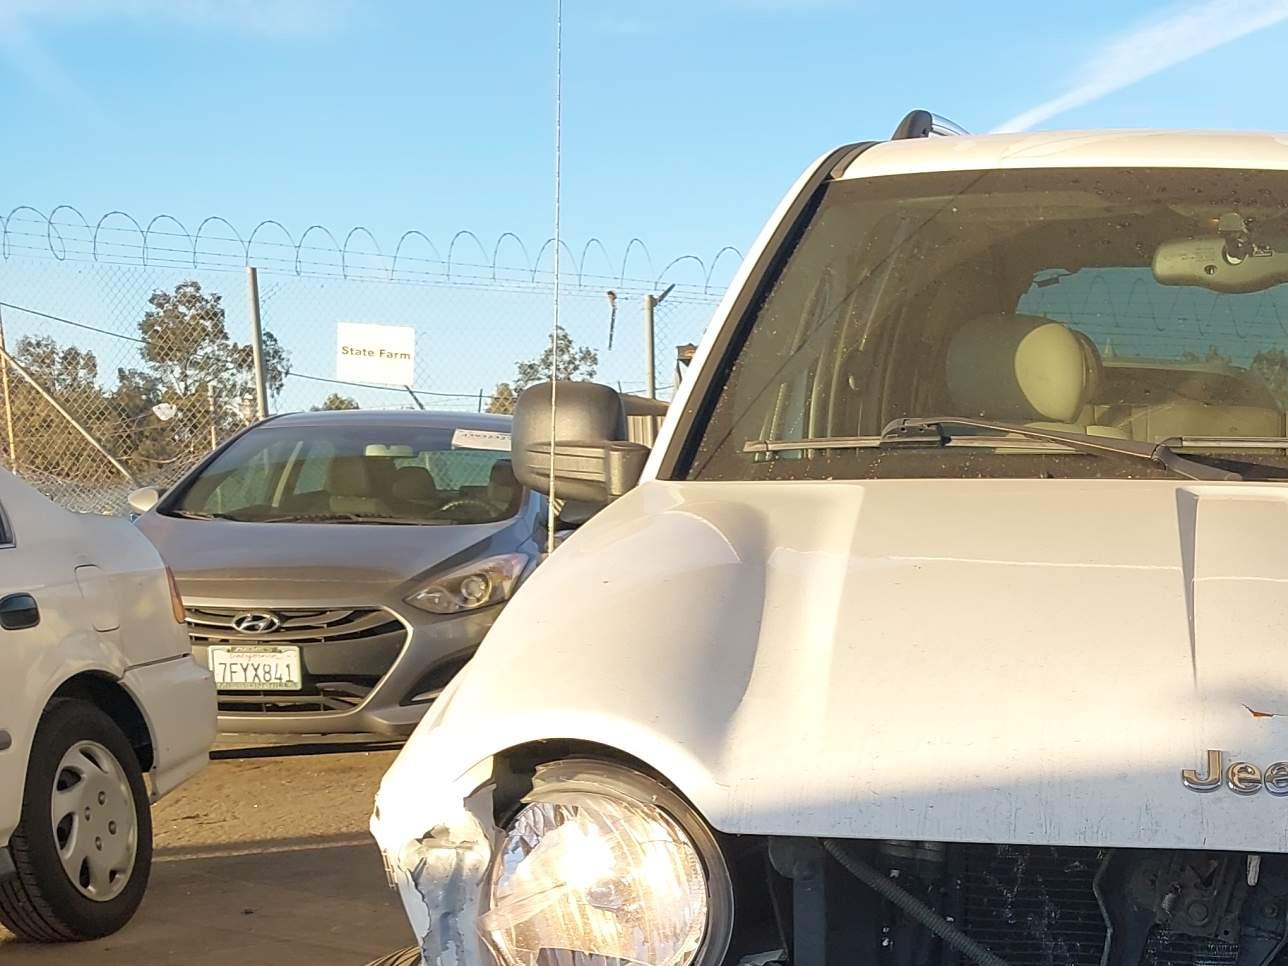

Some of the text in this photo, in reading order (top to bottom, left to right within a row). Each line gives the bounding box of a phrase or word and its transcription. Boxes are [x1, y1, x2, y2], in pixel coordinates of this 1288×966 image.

[342, 346, 411, 360] State Farm
[218, 663, 294, 683] 7FYX841
